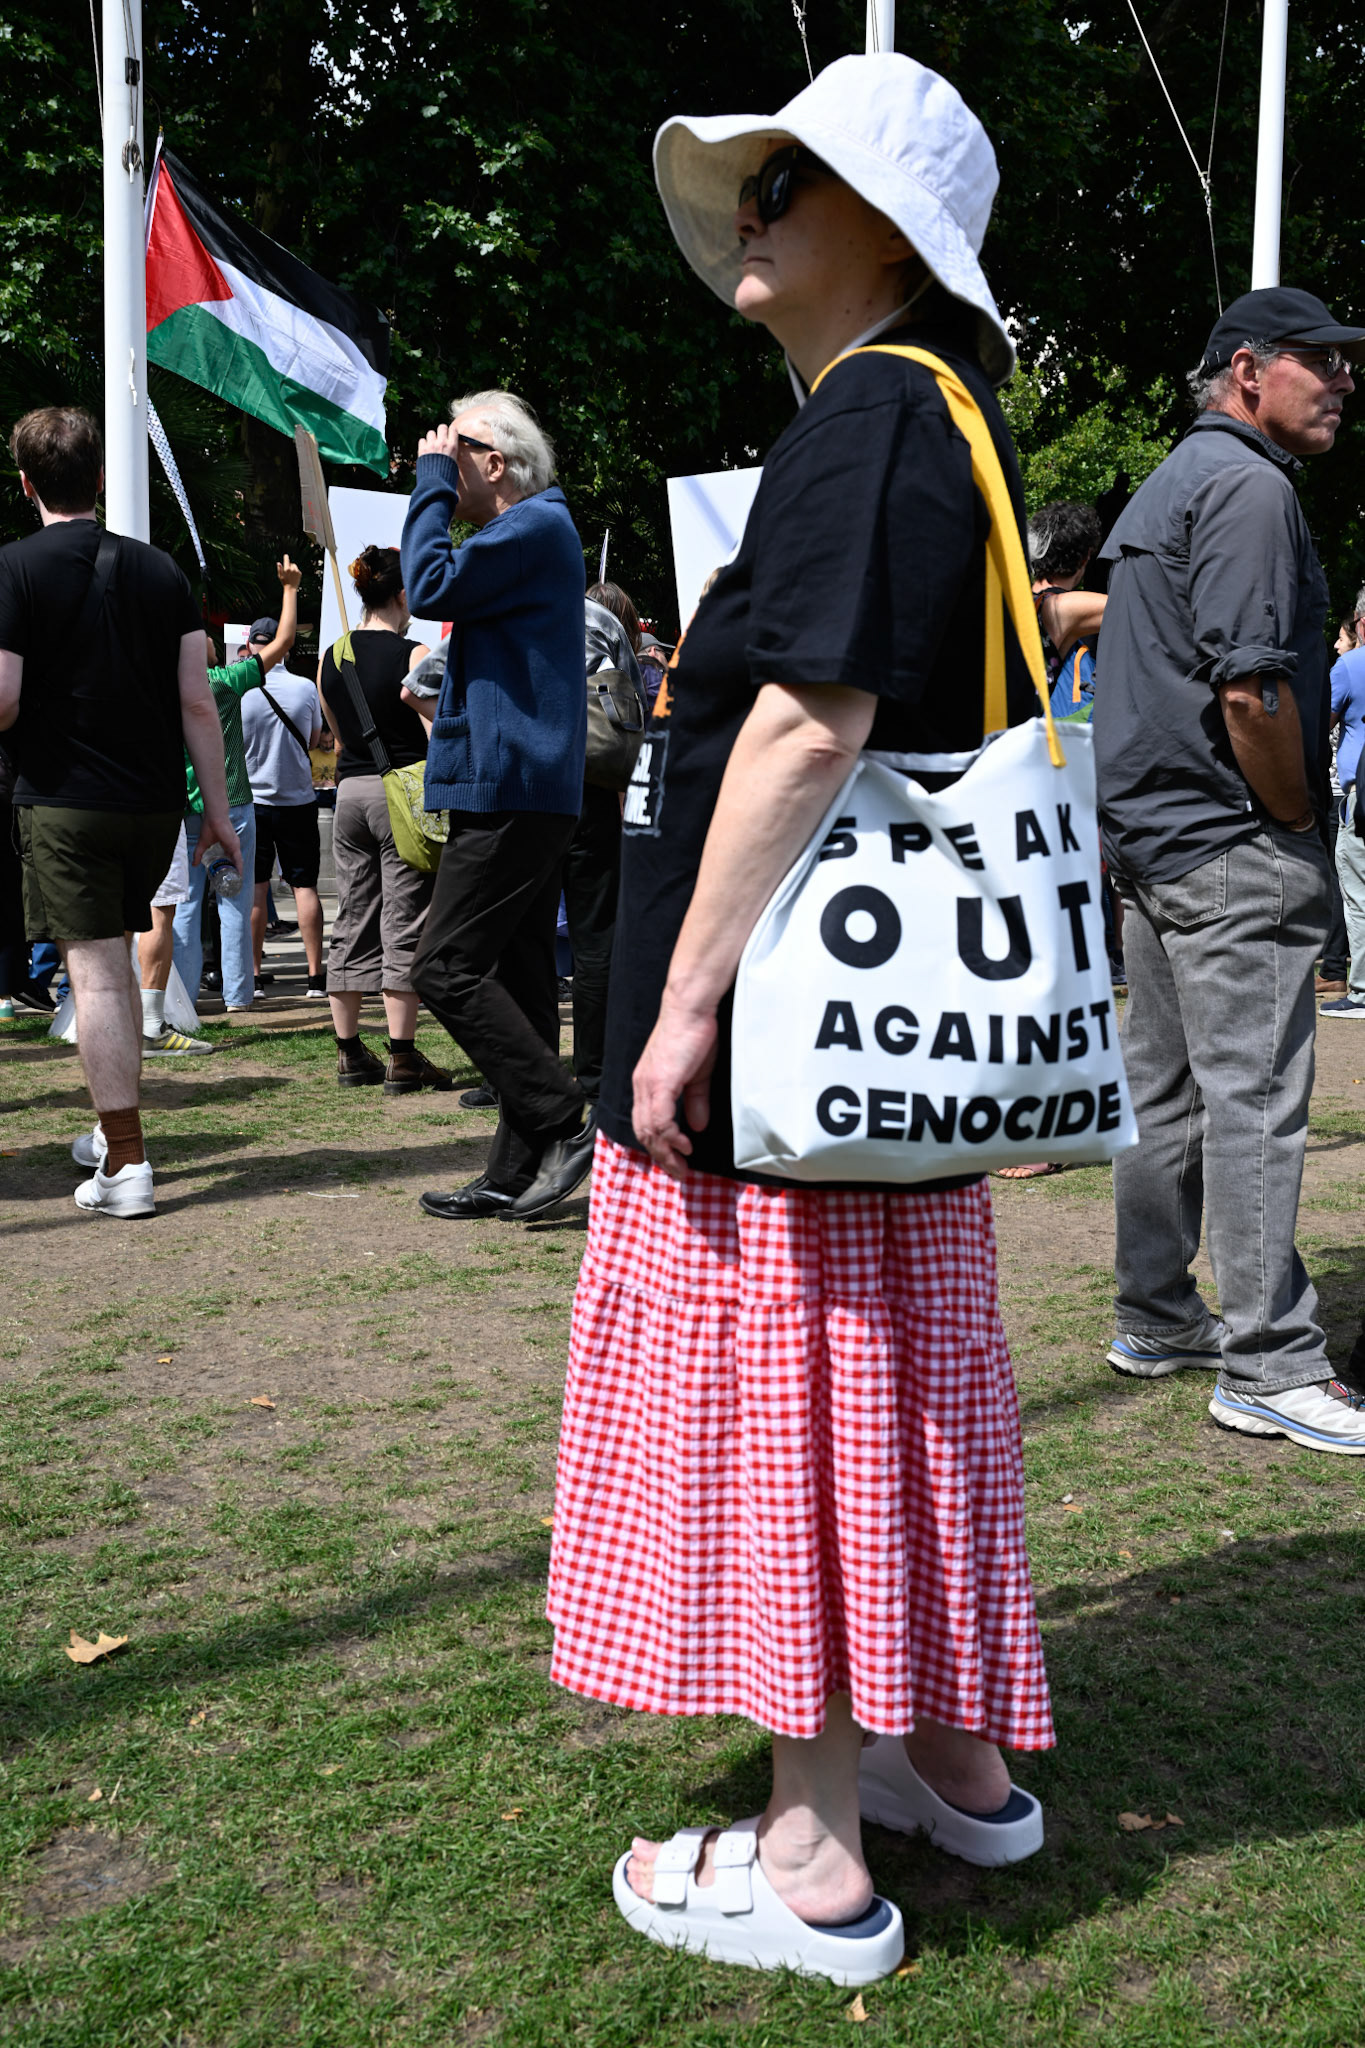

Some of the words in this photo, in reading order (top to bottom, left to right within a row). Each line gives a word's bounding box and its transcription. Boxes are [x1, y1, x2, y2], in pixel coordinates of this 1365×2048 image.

[819, 803, 1081, 871] SPEAK
[820, 880, 1091, 981] OUT
[814, 1000, 1110, 1065] AGAINST
[816, 1082, 1120, 1144] GENOCIDE
